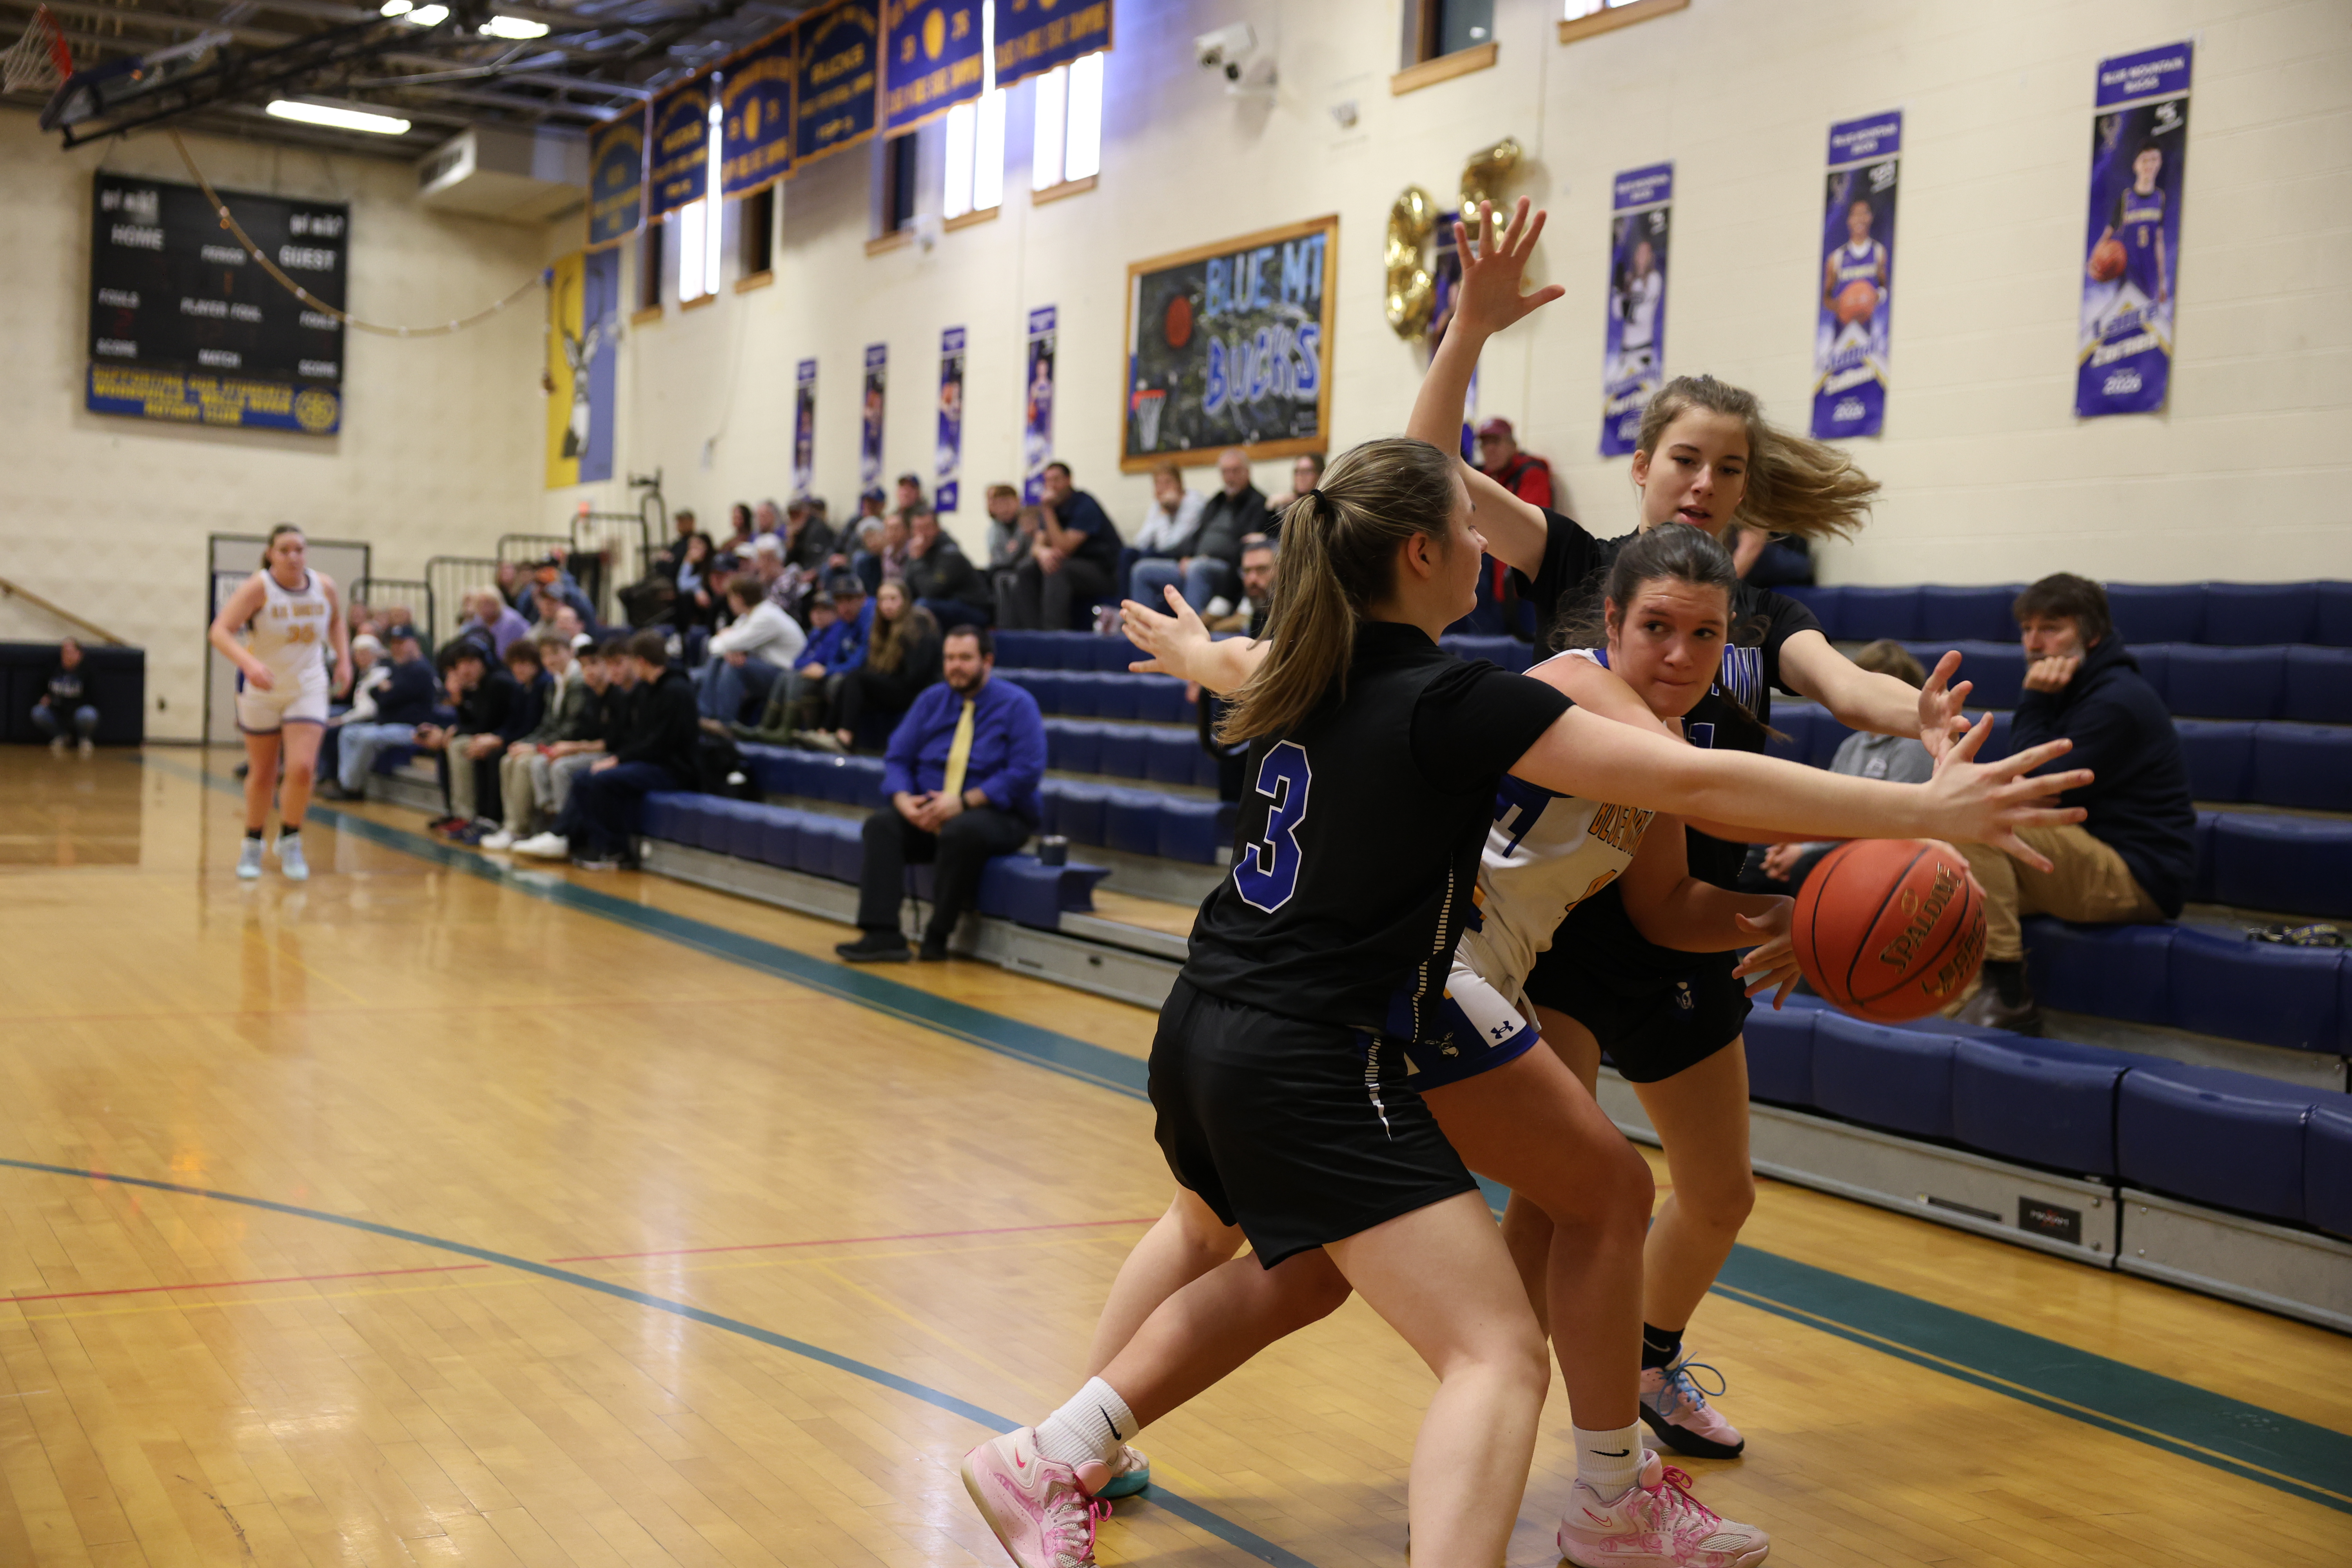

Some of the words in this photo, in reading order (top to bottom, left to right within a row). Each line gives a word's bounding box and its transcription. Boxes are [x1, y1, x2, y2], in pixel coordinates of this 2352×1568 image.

[111, 223, 165, 250] HOME
[201, 244, 247, 267] PERIOD
[279, 245, 337, 271] GUEST
[1204, 244, 1276, 317] BLUE
[180, 296, 229, 319] PLAYER
[230, 301, 263, 323] FOUL
[1202, 320, 1323, 416] BUCKS
[1233, 739, 1312, 914] 3
